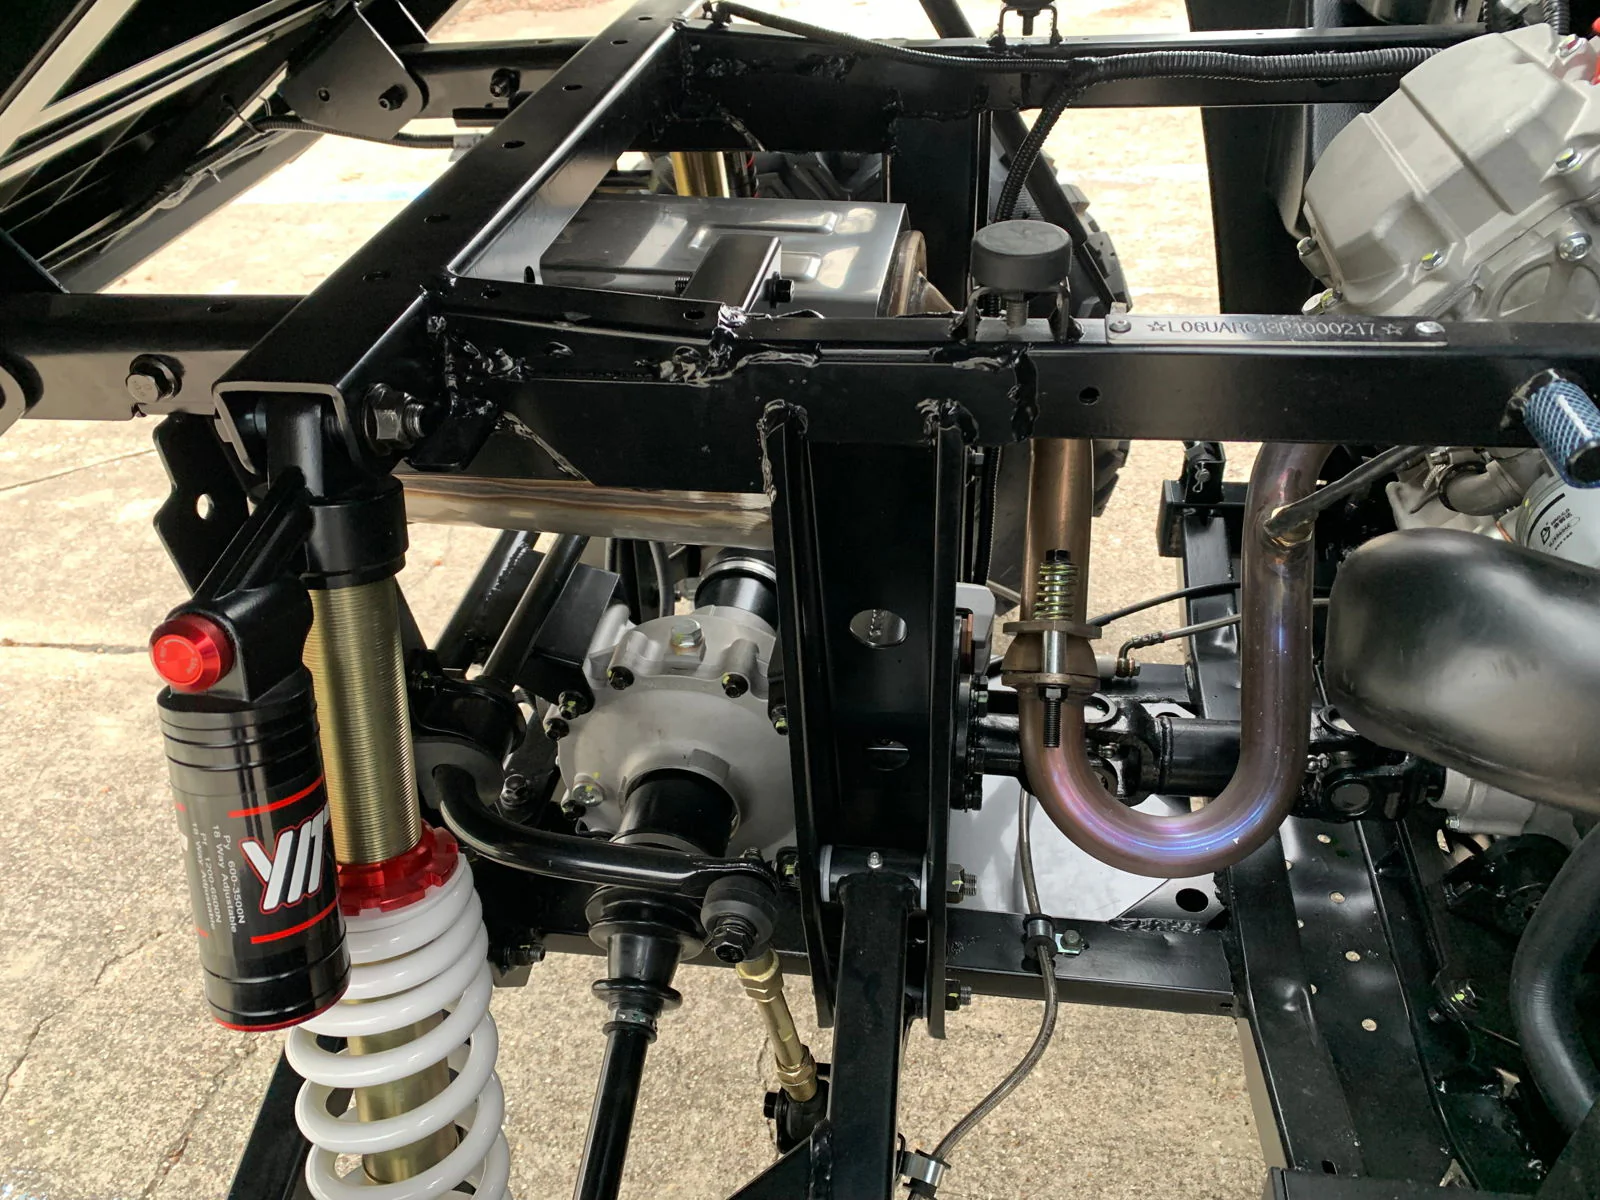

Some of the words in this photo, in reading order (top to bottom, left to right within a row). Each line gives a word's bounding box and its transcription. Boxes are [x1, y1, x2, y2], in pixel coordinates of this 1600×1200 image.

[195, 841, 204, 865] Way
[212, 825, 220, 838] 18
[216, 843, 225, 868] Way
[221, 873, 237, 933] Adjustable
[205, 857, 222, 923] 1200-6500N
[228, 861, 245, 924] 600-3500N
